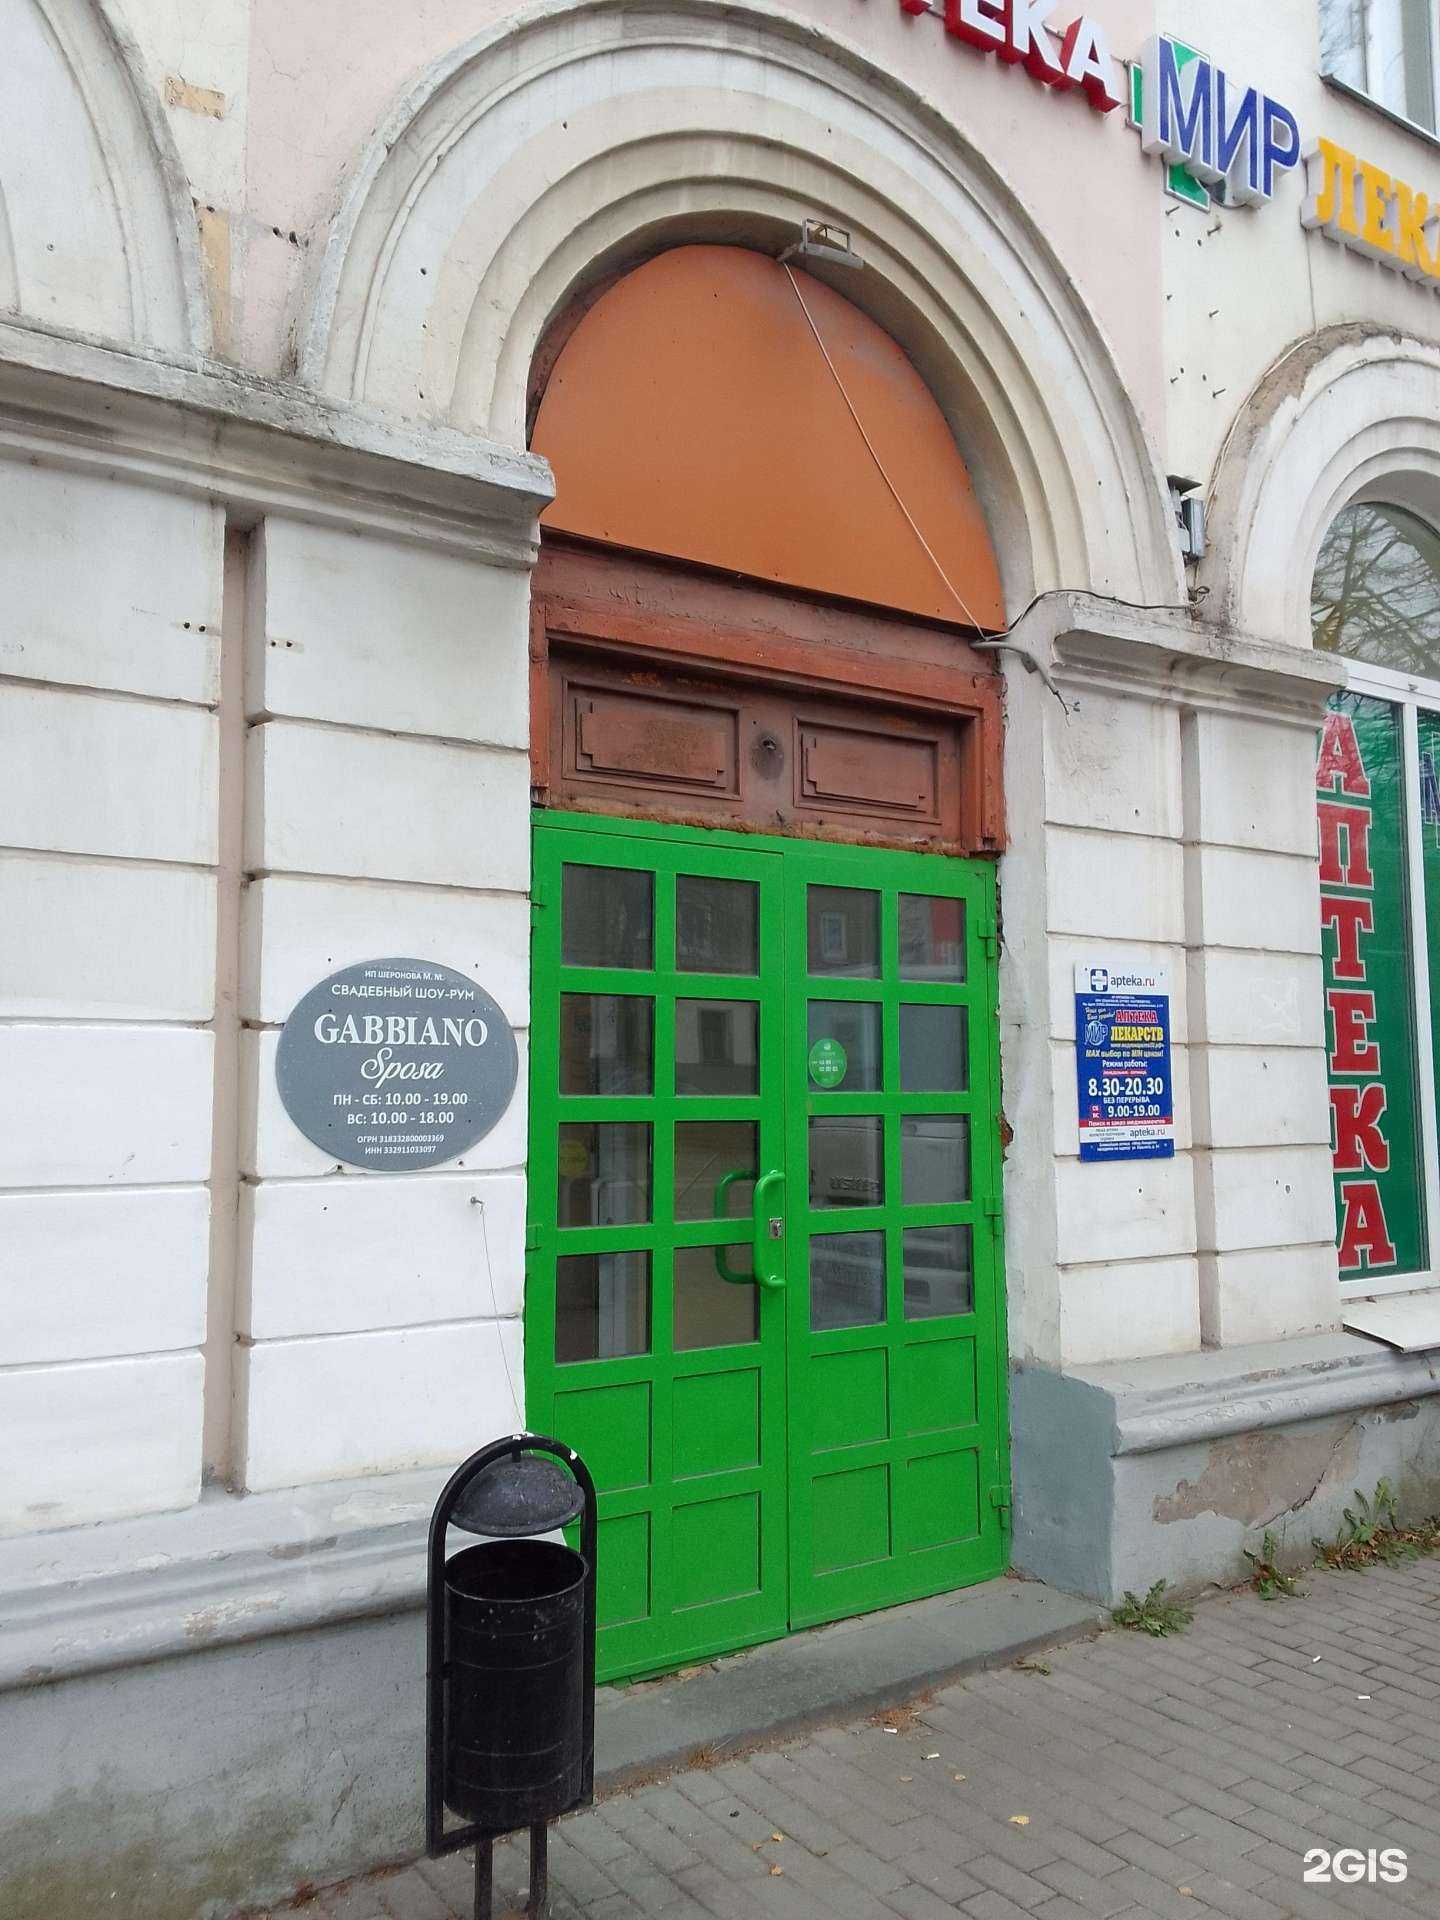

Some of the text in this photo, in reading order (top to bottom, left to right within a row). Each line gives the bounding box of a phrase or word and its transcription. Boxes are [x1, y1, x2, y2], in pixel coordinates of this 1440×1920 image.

[921, 0, 1440, 280] ЕКА МИР ЛЕК
[365, 970, 377, 978] ИП
[378, 970, 422, 980] ШЕРОНОВА
[1110, 974, 1155, 988] apteka.ru
[331, 984, 475, 1001] СВАДЕБНЫЙ ШОУ-РУМ
[1316, 710, 1397, 1269] АПТЕКА
[1115, 1010, 1158, 1023] АПТЕКА
[313, 1013, 488, 1047] GABBIANO
[1111, 1026, 1164, 1042] ЛЕКАРСТВ
[360, 1047, 446, 1089] Sposa
[1088, 1077, 1164, 1096] 8.30-20.30
[333, 1094, 352, 1106] ПН
[362, 1094, 382, 1105] СБ:
[385, 1093, 421, 1105] 10.00
[433, 1092, 468, 1105] 19.00
[1116, 1096, 1150, 1104] ПЕРЕРЫВА
[347, 1113, 367, 1125] ВС:
[371, 1112, 407, 1124] 10.00
[419, 1111, 455, 1124] 18.00
[1107, 1105, 1160, 1118] 9.00-19.00
[1129, 1128, 1166, 1139] apteka.ru
